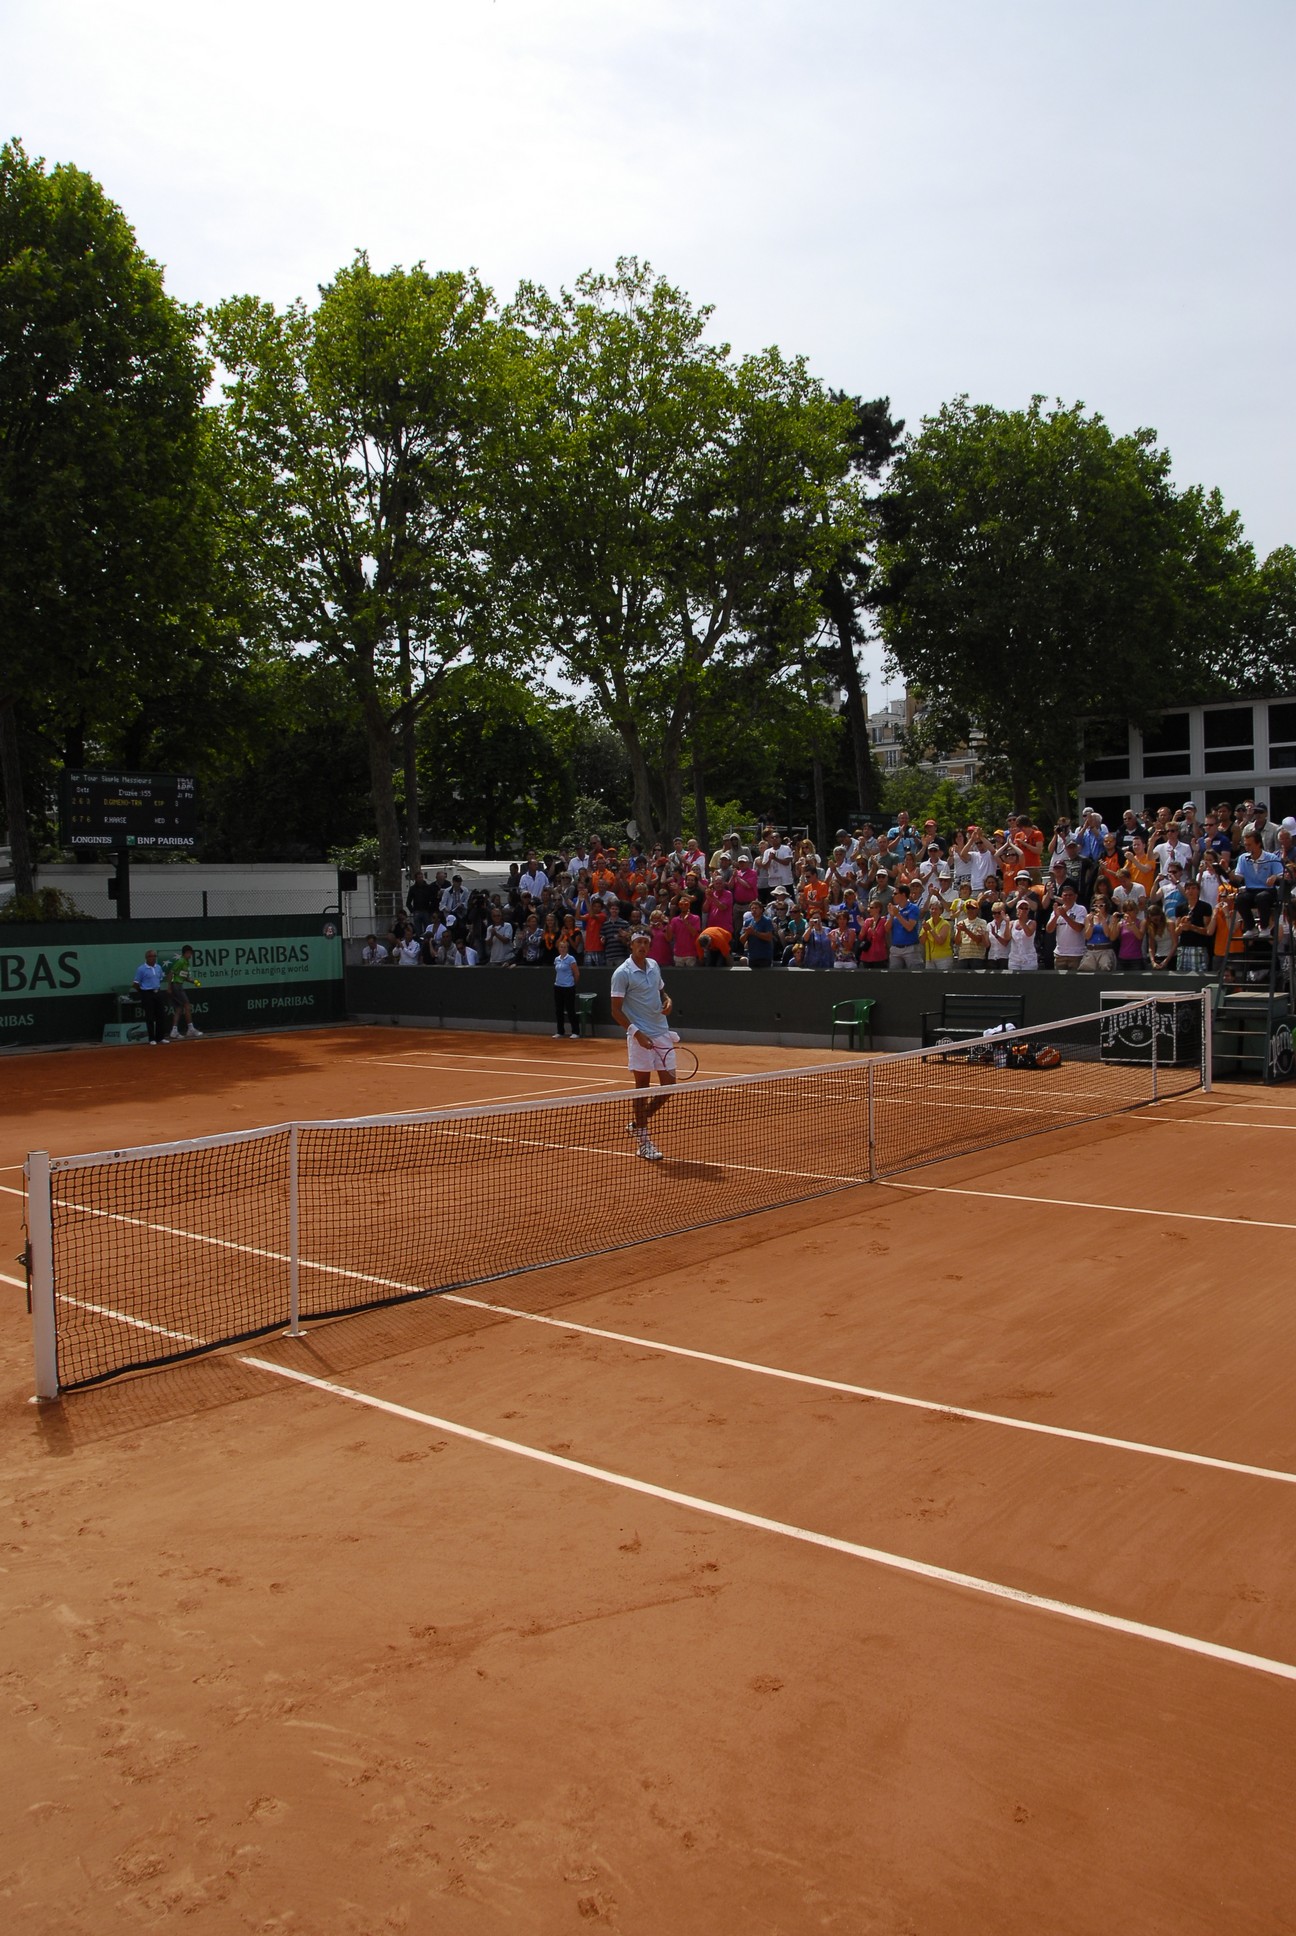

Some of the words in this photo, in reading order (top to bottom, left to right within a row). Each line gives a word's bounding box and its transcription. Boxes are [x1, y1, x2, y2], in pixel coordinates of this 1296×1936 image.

[71, 836, 112, 844] LONGINES
[157, 837, 194, 845] PARIBAS
[192, 948, 230, 967] BNP
[235, 944, 310, 965] PARIBAS
[0, 951, 81, 992] BAS
[193, 970, 206, 978] The
[209, 968, 229, 977] bank
[230, 968, 242, 978] for
[252, 966, 287, 976] changing
[287, 964, 309, 973] world
[248, 999, 269, 1010] BNP
[271, 995, 315, 1009] PARIBAS
